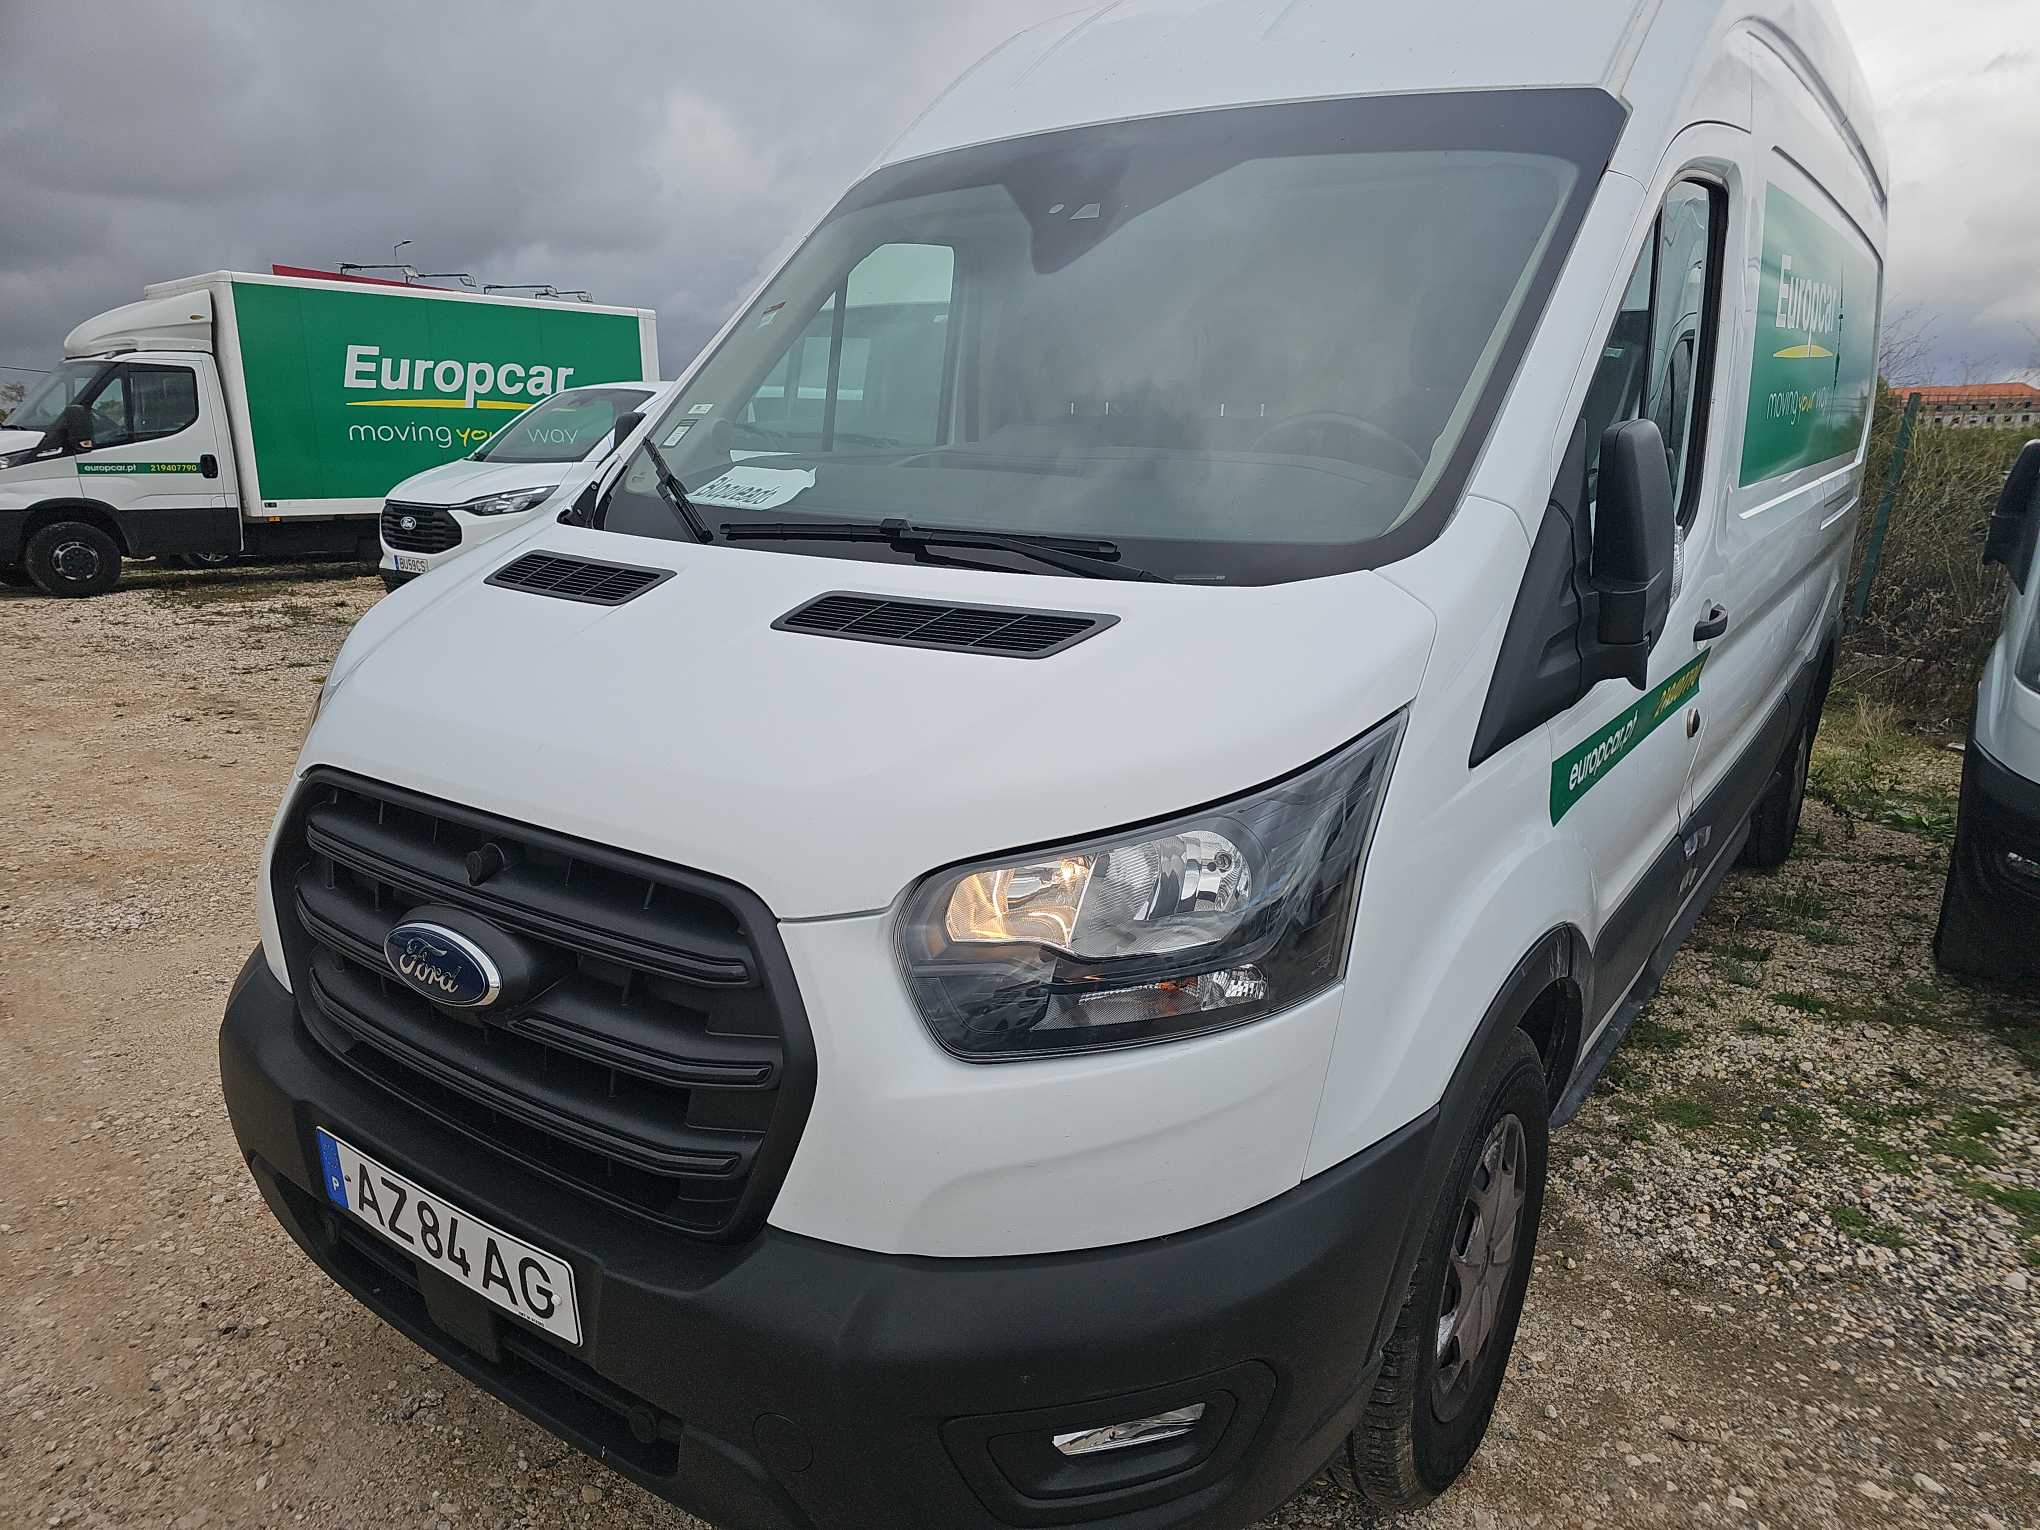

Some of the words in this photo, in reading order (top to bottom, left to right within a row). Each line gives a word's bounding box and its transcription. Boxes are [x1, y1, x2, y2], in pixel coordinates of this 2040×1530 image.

[1775, 255, 1836, 357] Europcar
[343, 344, 575, 408] Europcar
[1767, 385, 1800, 425] moving
[349, 421, 452, 448] moving
[527, 427, 579, 444] way
[84, 463, 137, 473] europcar.pt
[150, 464, 198, 472] 219407790
[400, 937, 463, 993] Ford
[331, 1175, 340, 1191] P
